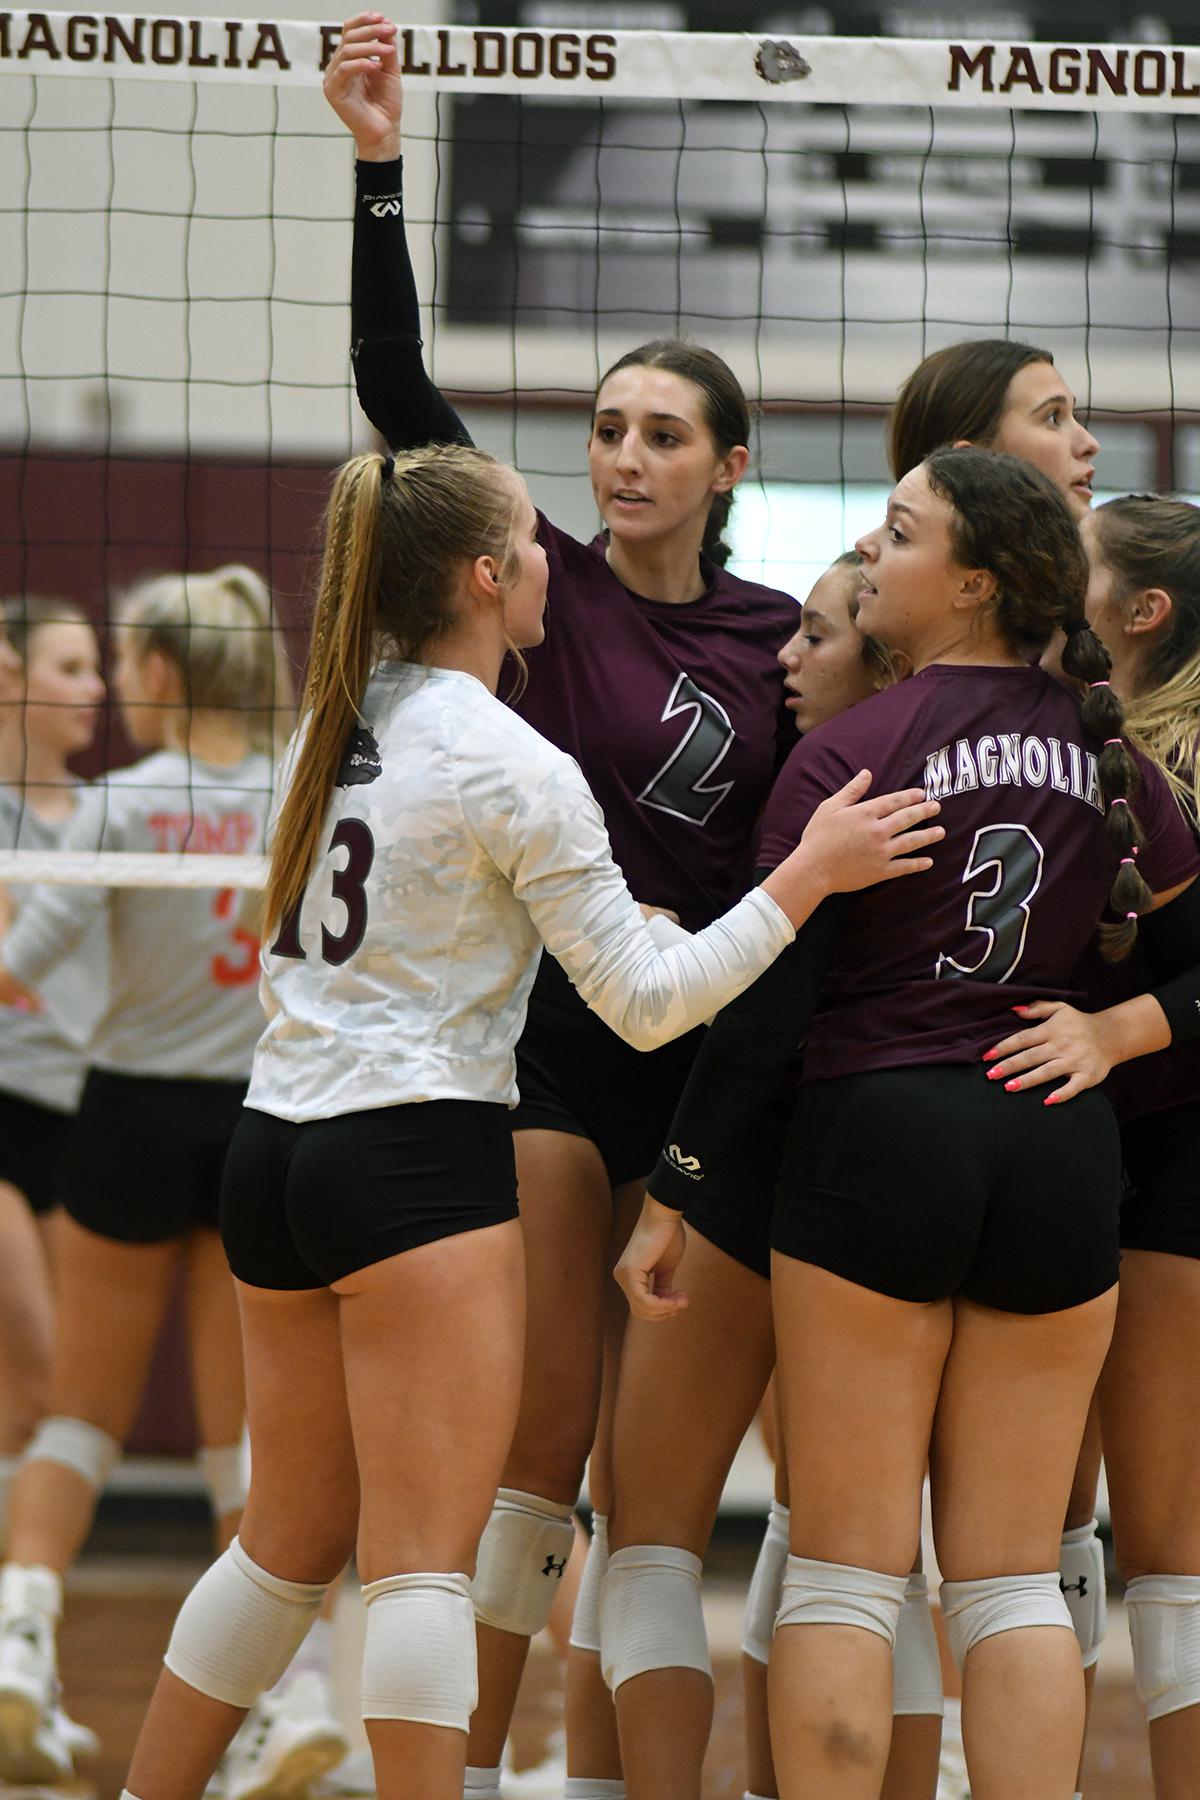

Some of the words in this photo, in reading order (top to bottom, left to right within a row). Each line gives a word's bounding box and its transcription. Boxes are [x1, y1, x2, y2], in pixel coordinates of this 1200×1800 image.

[319, 26, 617, 81] LLDOGS
[947, 45, 1200, 97] MAGNOL
[636, 671, 736, 827] 2
[924, 733, 1105, 815] MAGNOLIA
[935, 823, 1044, 984] 3
